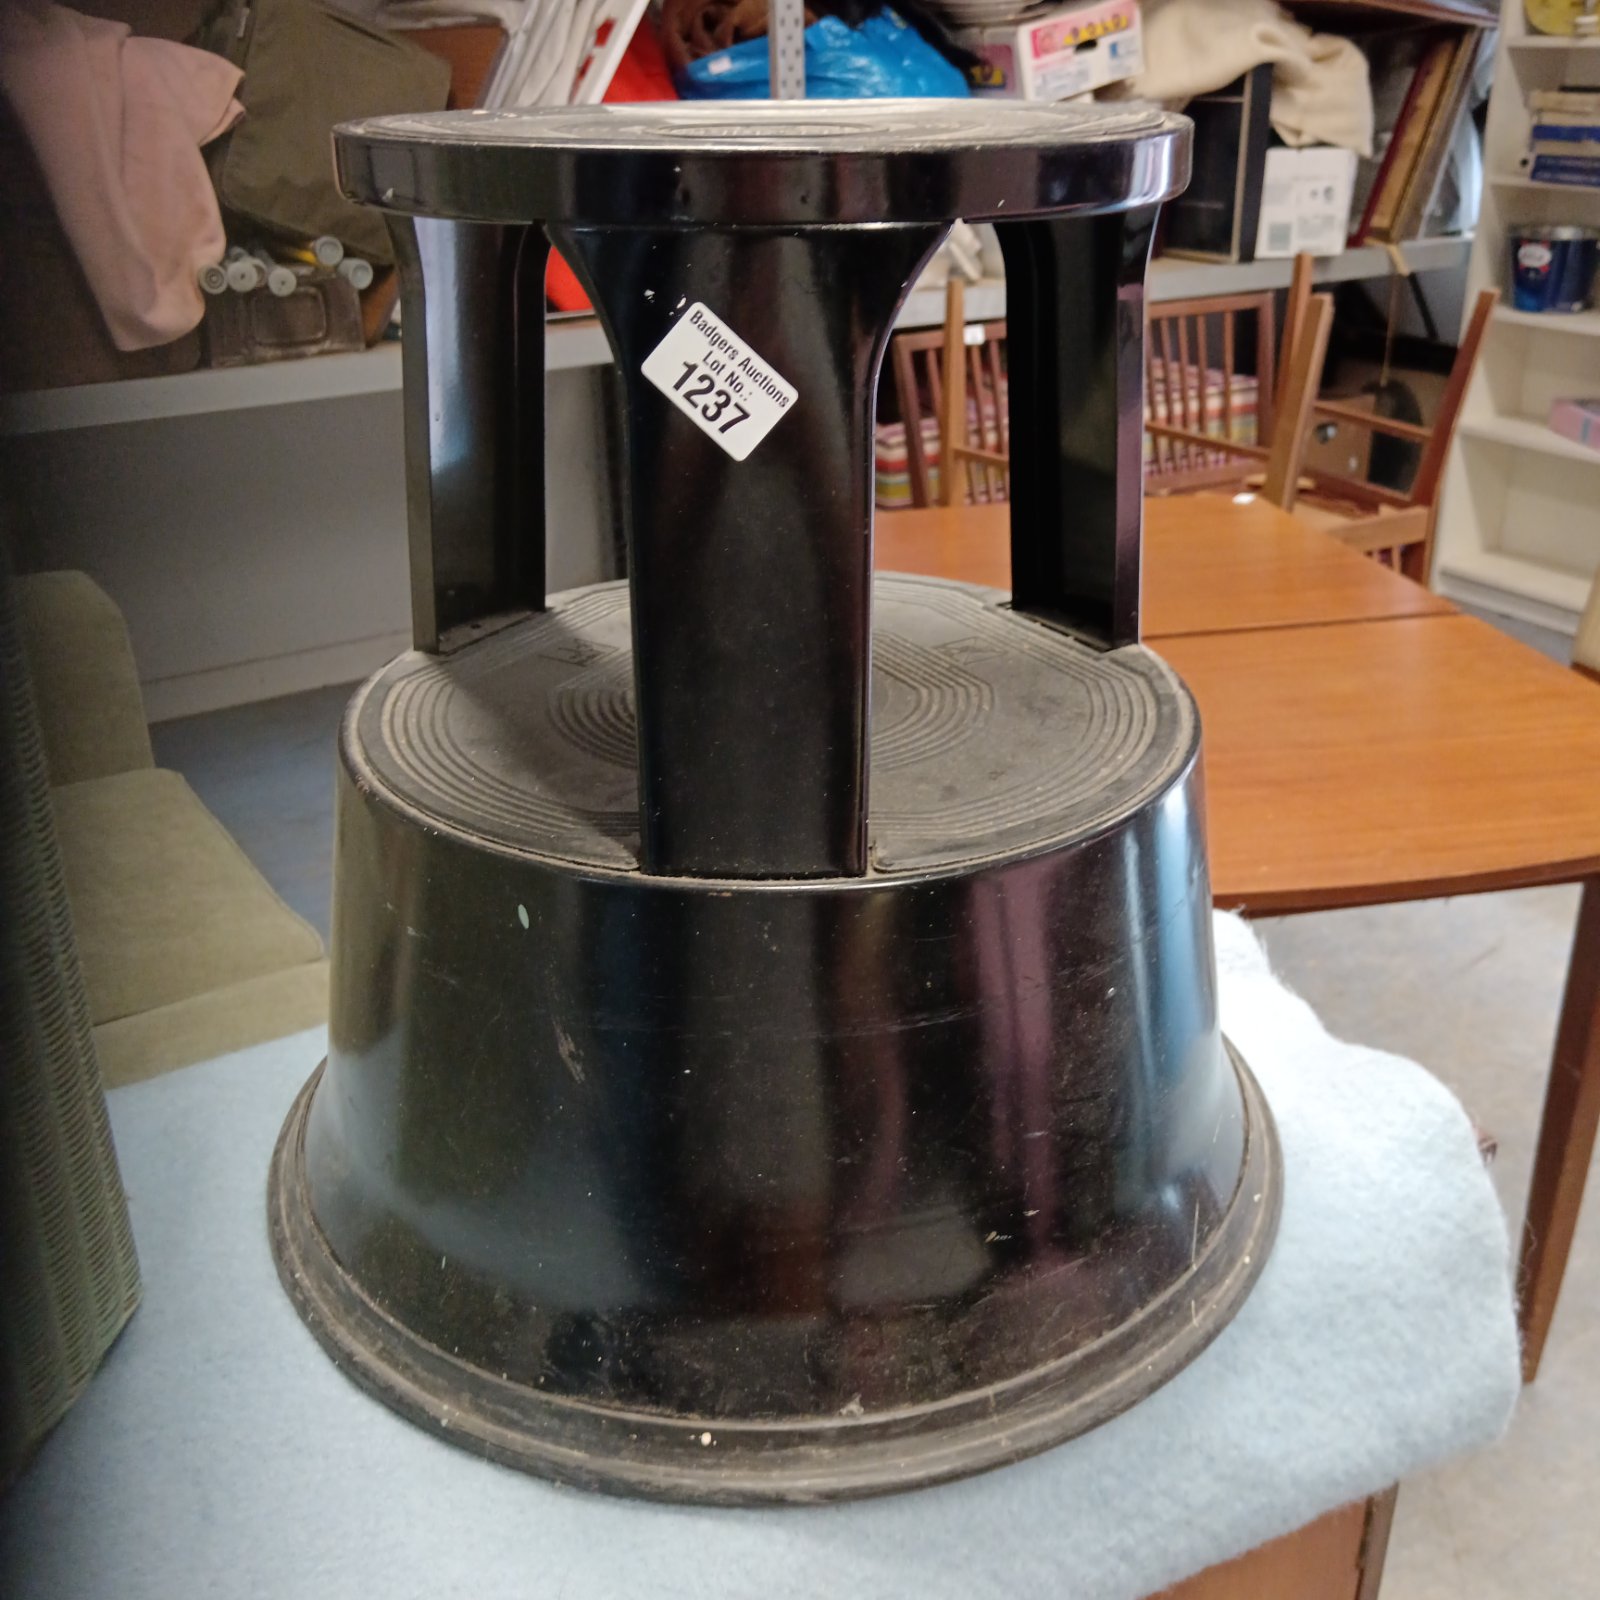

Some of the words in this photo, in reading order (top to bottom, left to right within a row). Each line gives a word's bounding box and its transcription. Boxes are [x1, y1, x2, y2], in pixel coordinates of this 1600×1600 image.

[689, 310, 739, 361] Badgers
[738, 357, 790, 408] Auctions
[702, 350, 726, 376] Lot
[672, 361, 751, 434] 1237
